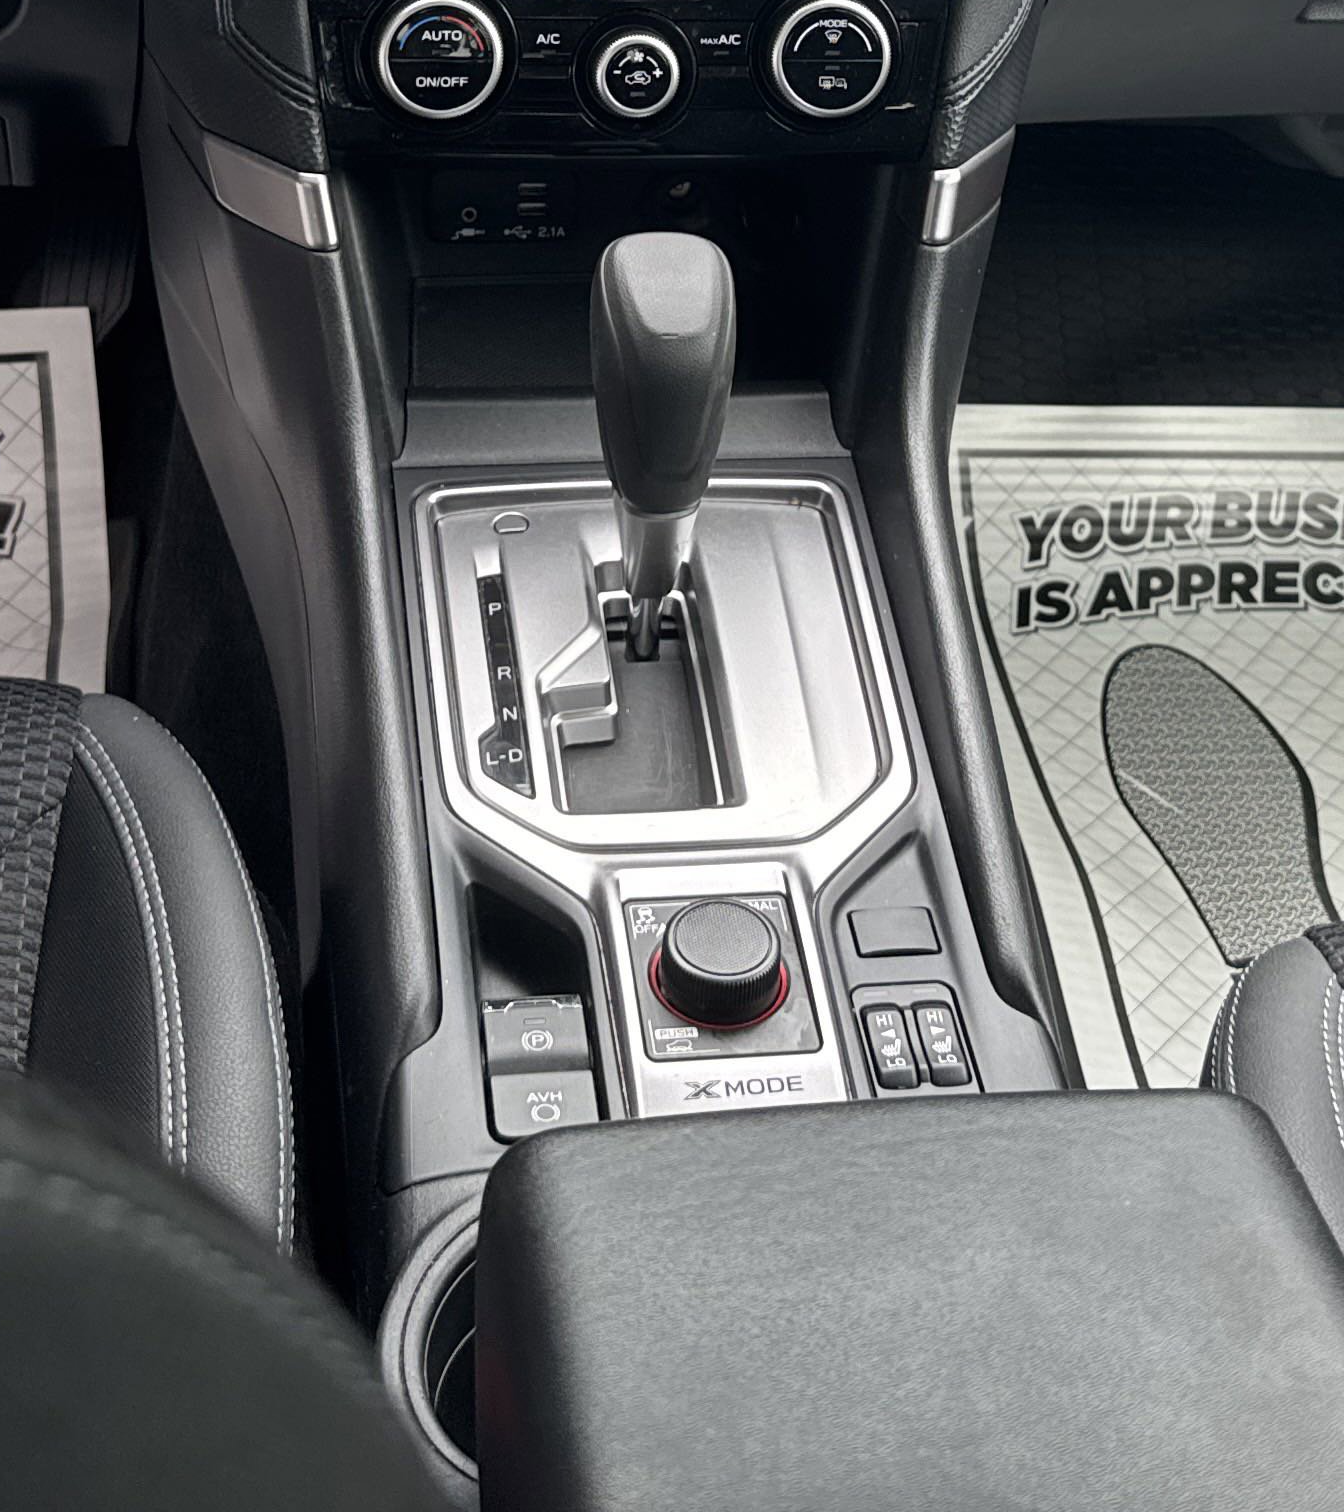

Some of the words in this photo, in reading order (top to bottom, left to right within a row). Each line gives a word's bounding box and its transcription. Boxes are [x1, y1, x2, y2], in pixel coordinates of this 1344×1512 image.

[819, 19, 848, 28] MODE
[421, 30, 463, 42] AUTO
[536, 33, 561, 45] A/C
[415, 76, 469, 88] ON/OFF
[1017, 493, 1196, 564] YOUR
[488, 602, 502, 616] P
[1014, 582, 1073, 630] IS
[497, 666, 512, 680] R
[502, 706, 518, 722] N
[486, 748, 523, 766] L-D
[876, 1013, 893, 1027] HI
[926, 1010, 944, 1023] HI
[658, 1028, 694, 1038] PUSH
[886, 1057, 907, 1068] LO
[937, 1054, 957, 1064] LO
[724, 1075, 805, 1097] MODE
[526, 1090, 563, 1104] AVH
